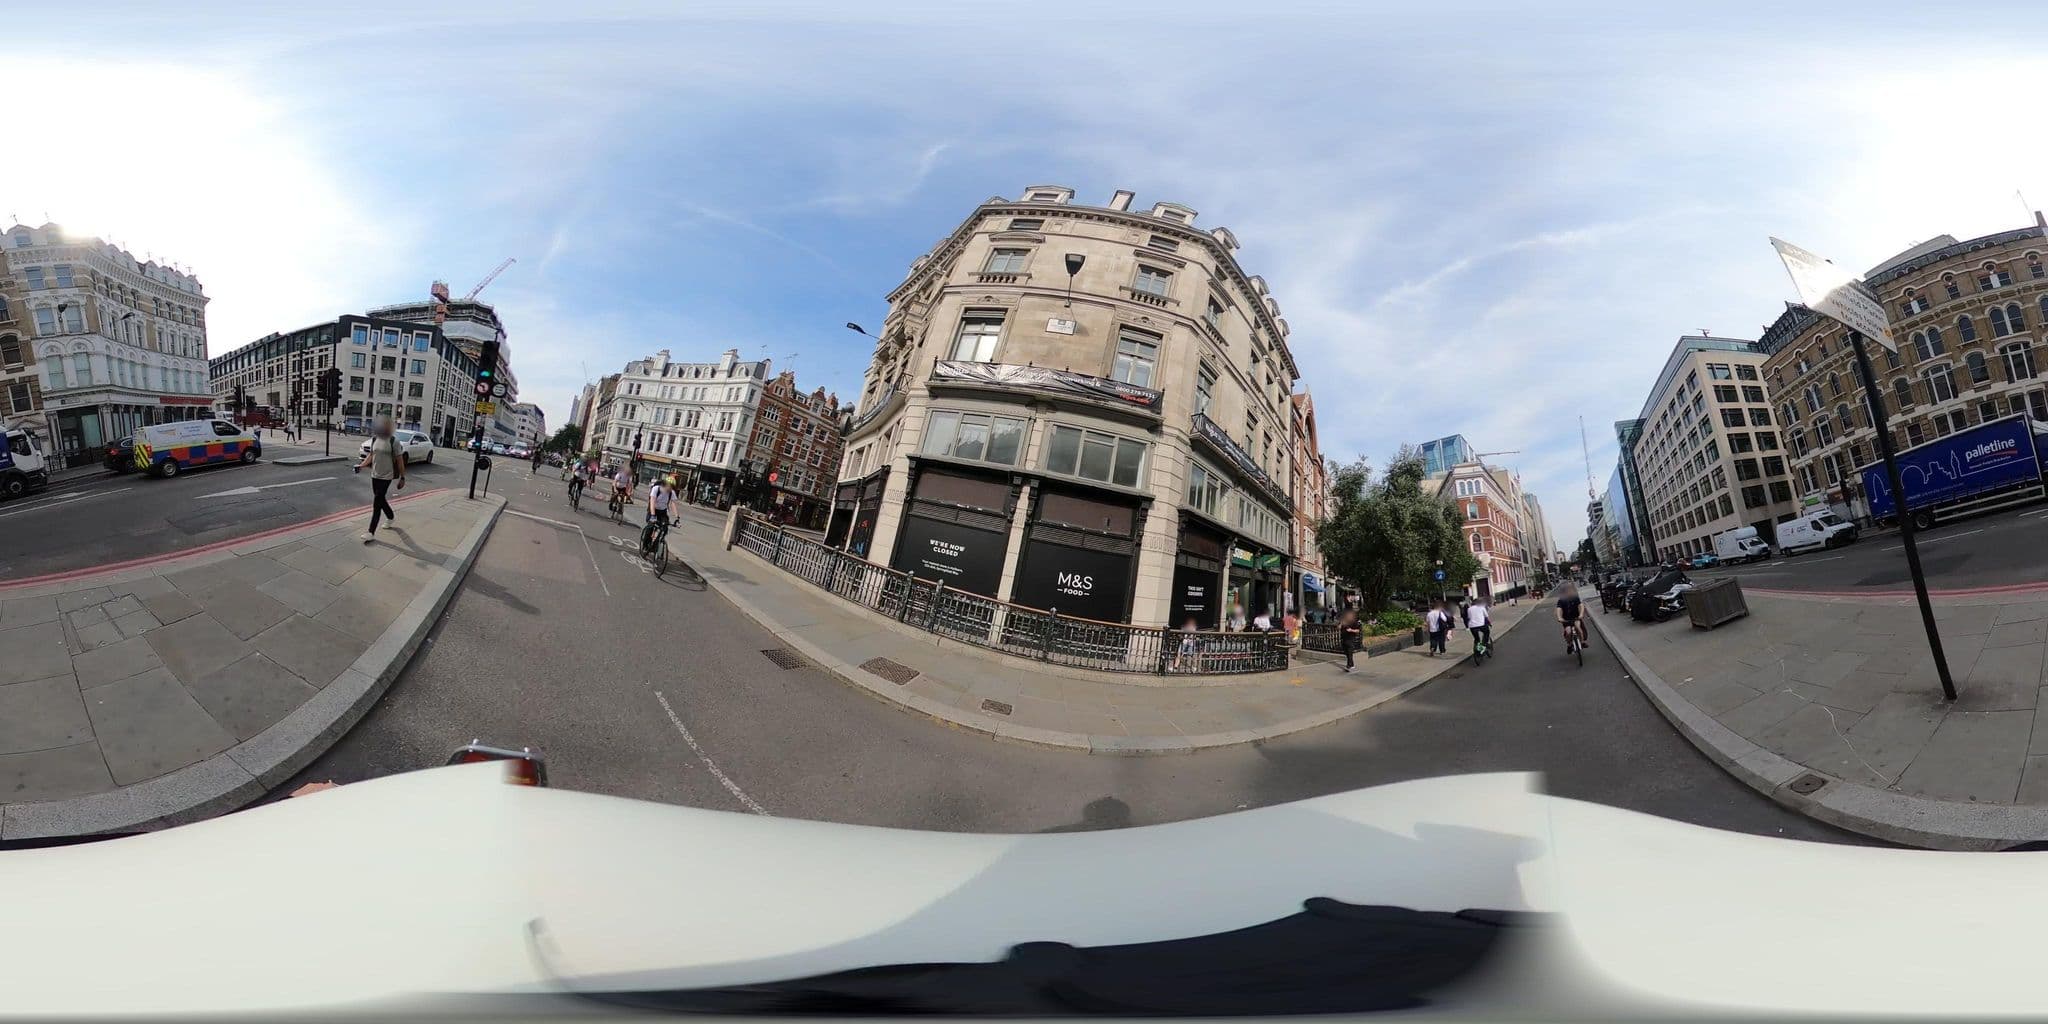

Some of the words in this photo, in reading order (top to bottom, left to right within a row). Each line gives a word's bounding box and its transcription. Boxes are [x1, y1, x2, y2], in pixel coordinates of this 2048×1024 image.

[1965, 438, 2016, 462] palletline
[929, 539, 949, 549] WE'RE
[949, 543, 966, 552] NOW
[933, 546, 959, 557] CLOSED
[1057, 571, 1093, 590] M&S
[1063, 588, 1083, 597] FOOD
